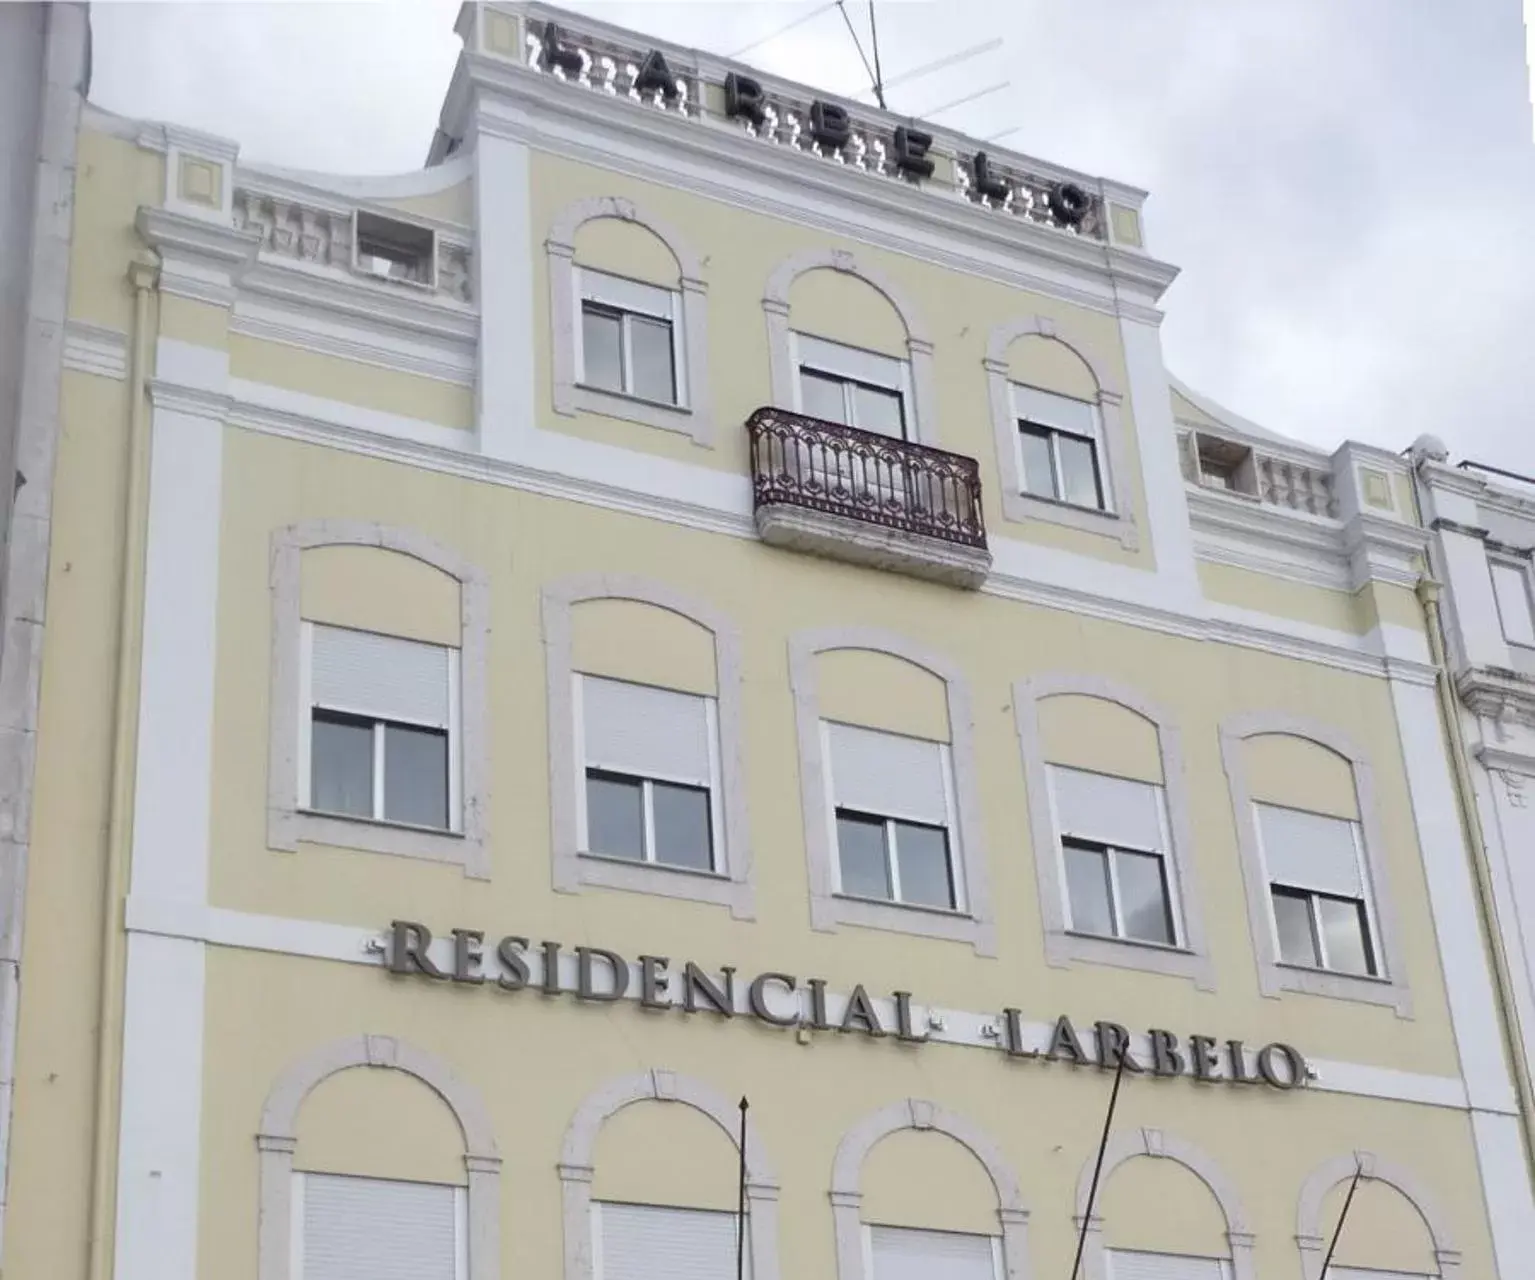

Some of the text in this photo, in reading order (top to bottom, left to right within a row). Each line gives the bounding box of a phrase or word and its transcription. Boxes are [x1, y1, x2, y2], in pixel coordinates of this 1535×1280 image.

[544, 22, 1093, 226] LARBELO
[384, 919, 1306, 1090] RESIDENCIAL LARBELO
